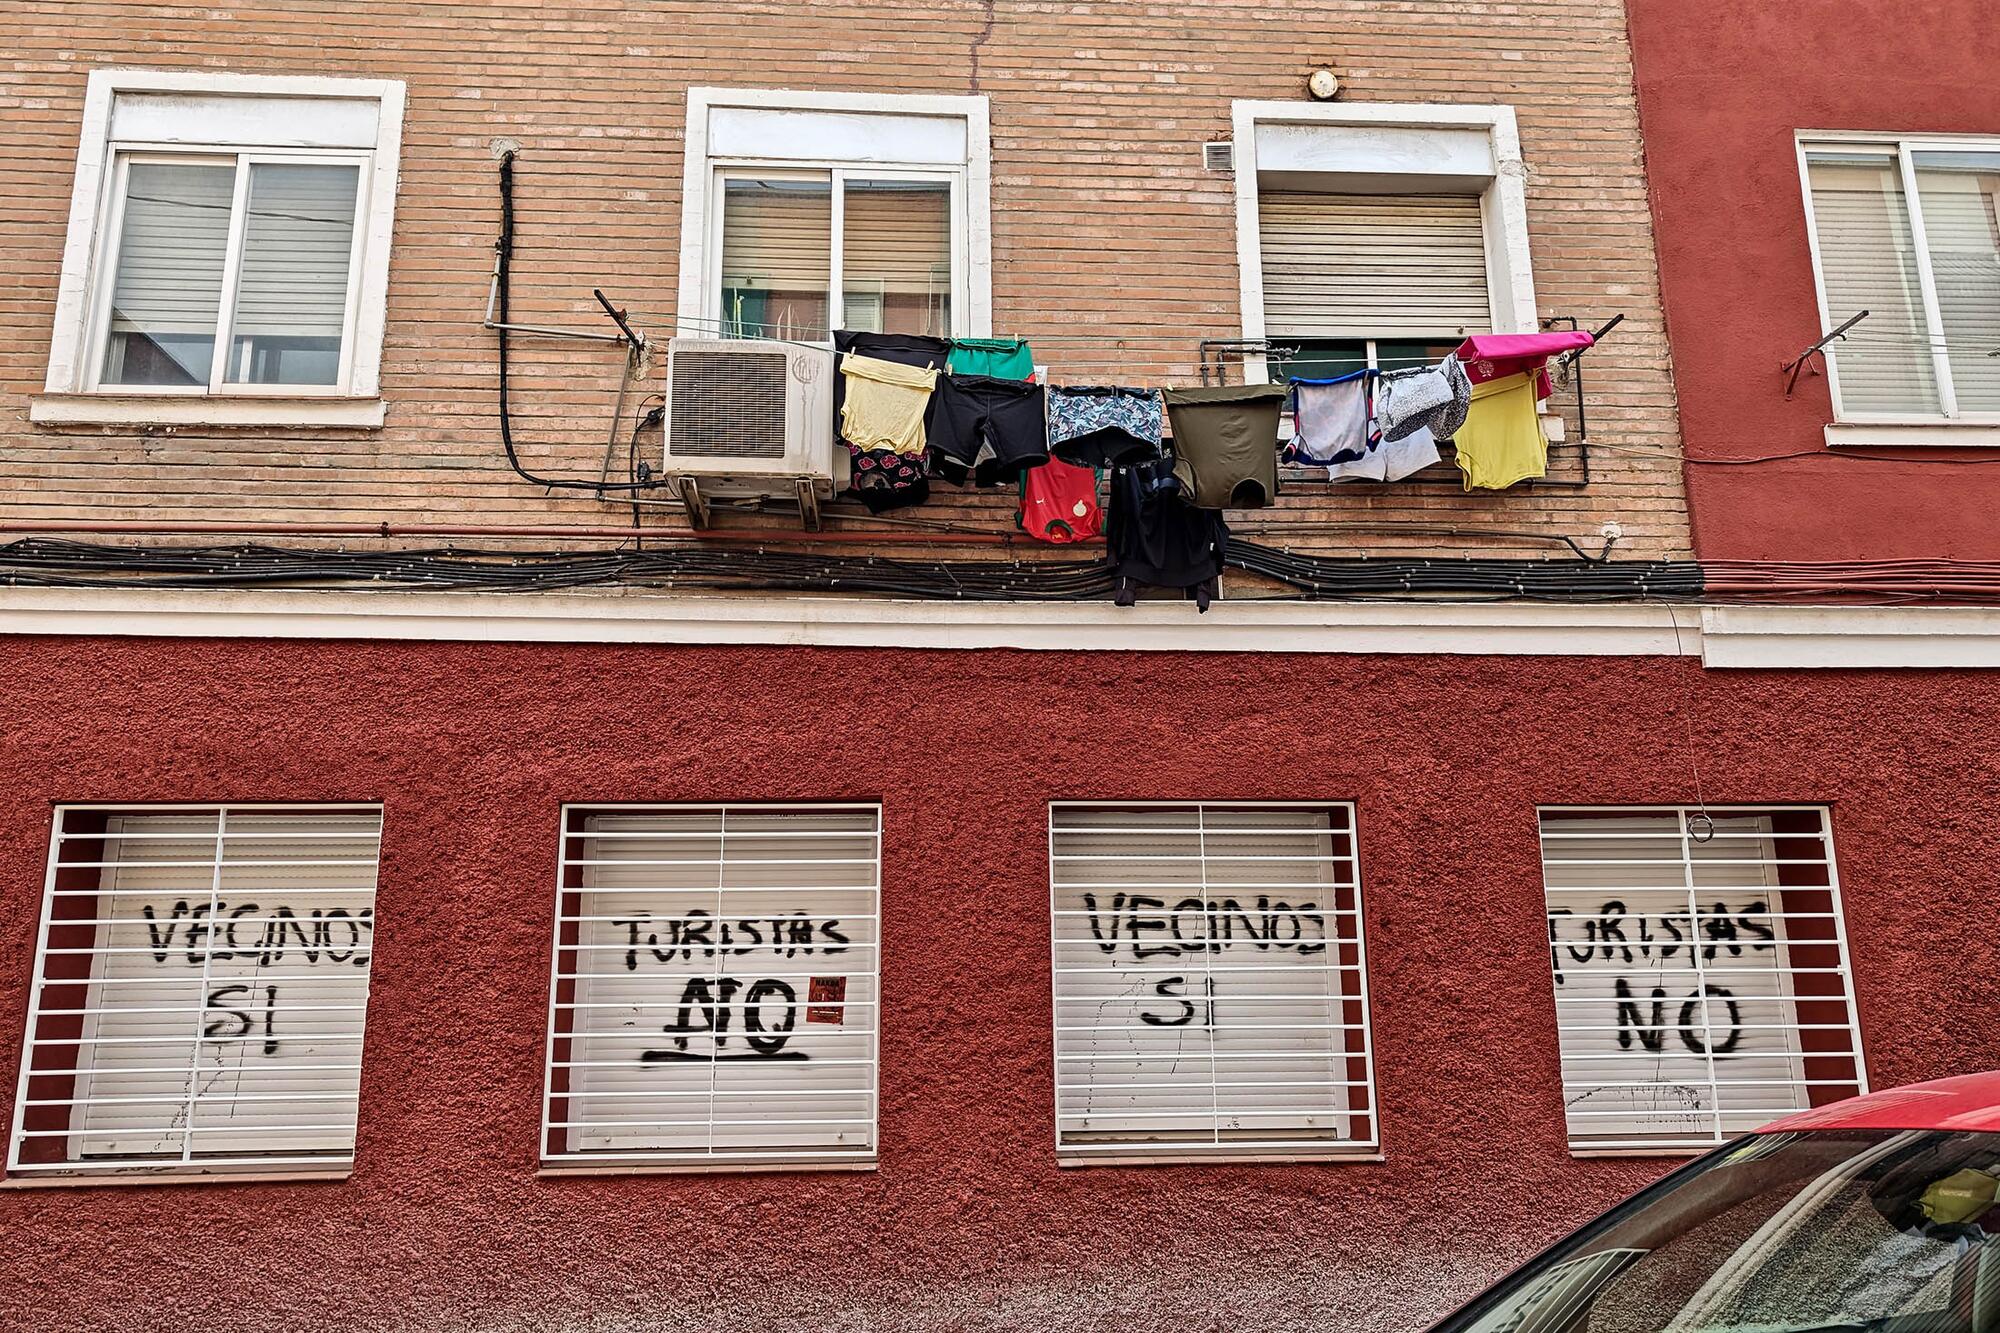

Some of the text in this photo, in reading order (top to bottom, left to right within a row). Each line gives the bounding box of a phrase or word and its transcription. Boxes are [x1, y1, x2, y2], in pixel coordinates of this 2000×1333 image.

[143, 901, 372, 966] VECINOS
[612, 909, 850, 970] TURISTAS
[1084, 892, 1325, 958] VECINOS
[1548, 901, 1775, 984] TURISTAS
[204, 985, 281, 1054] SI
[664, 977, 797, 1052] NO
[1141, 977, 1214, 1033] SI
[1615, 978, 1742, 1056] NO
